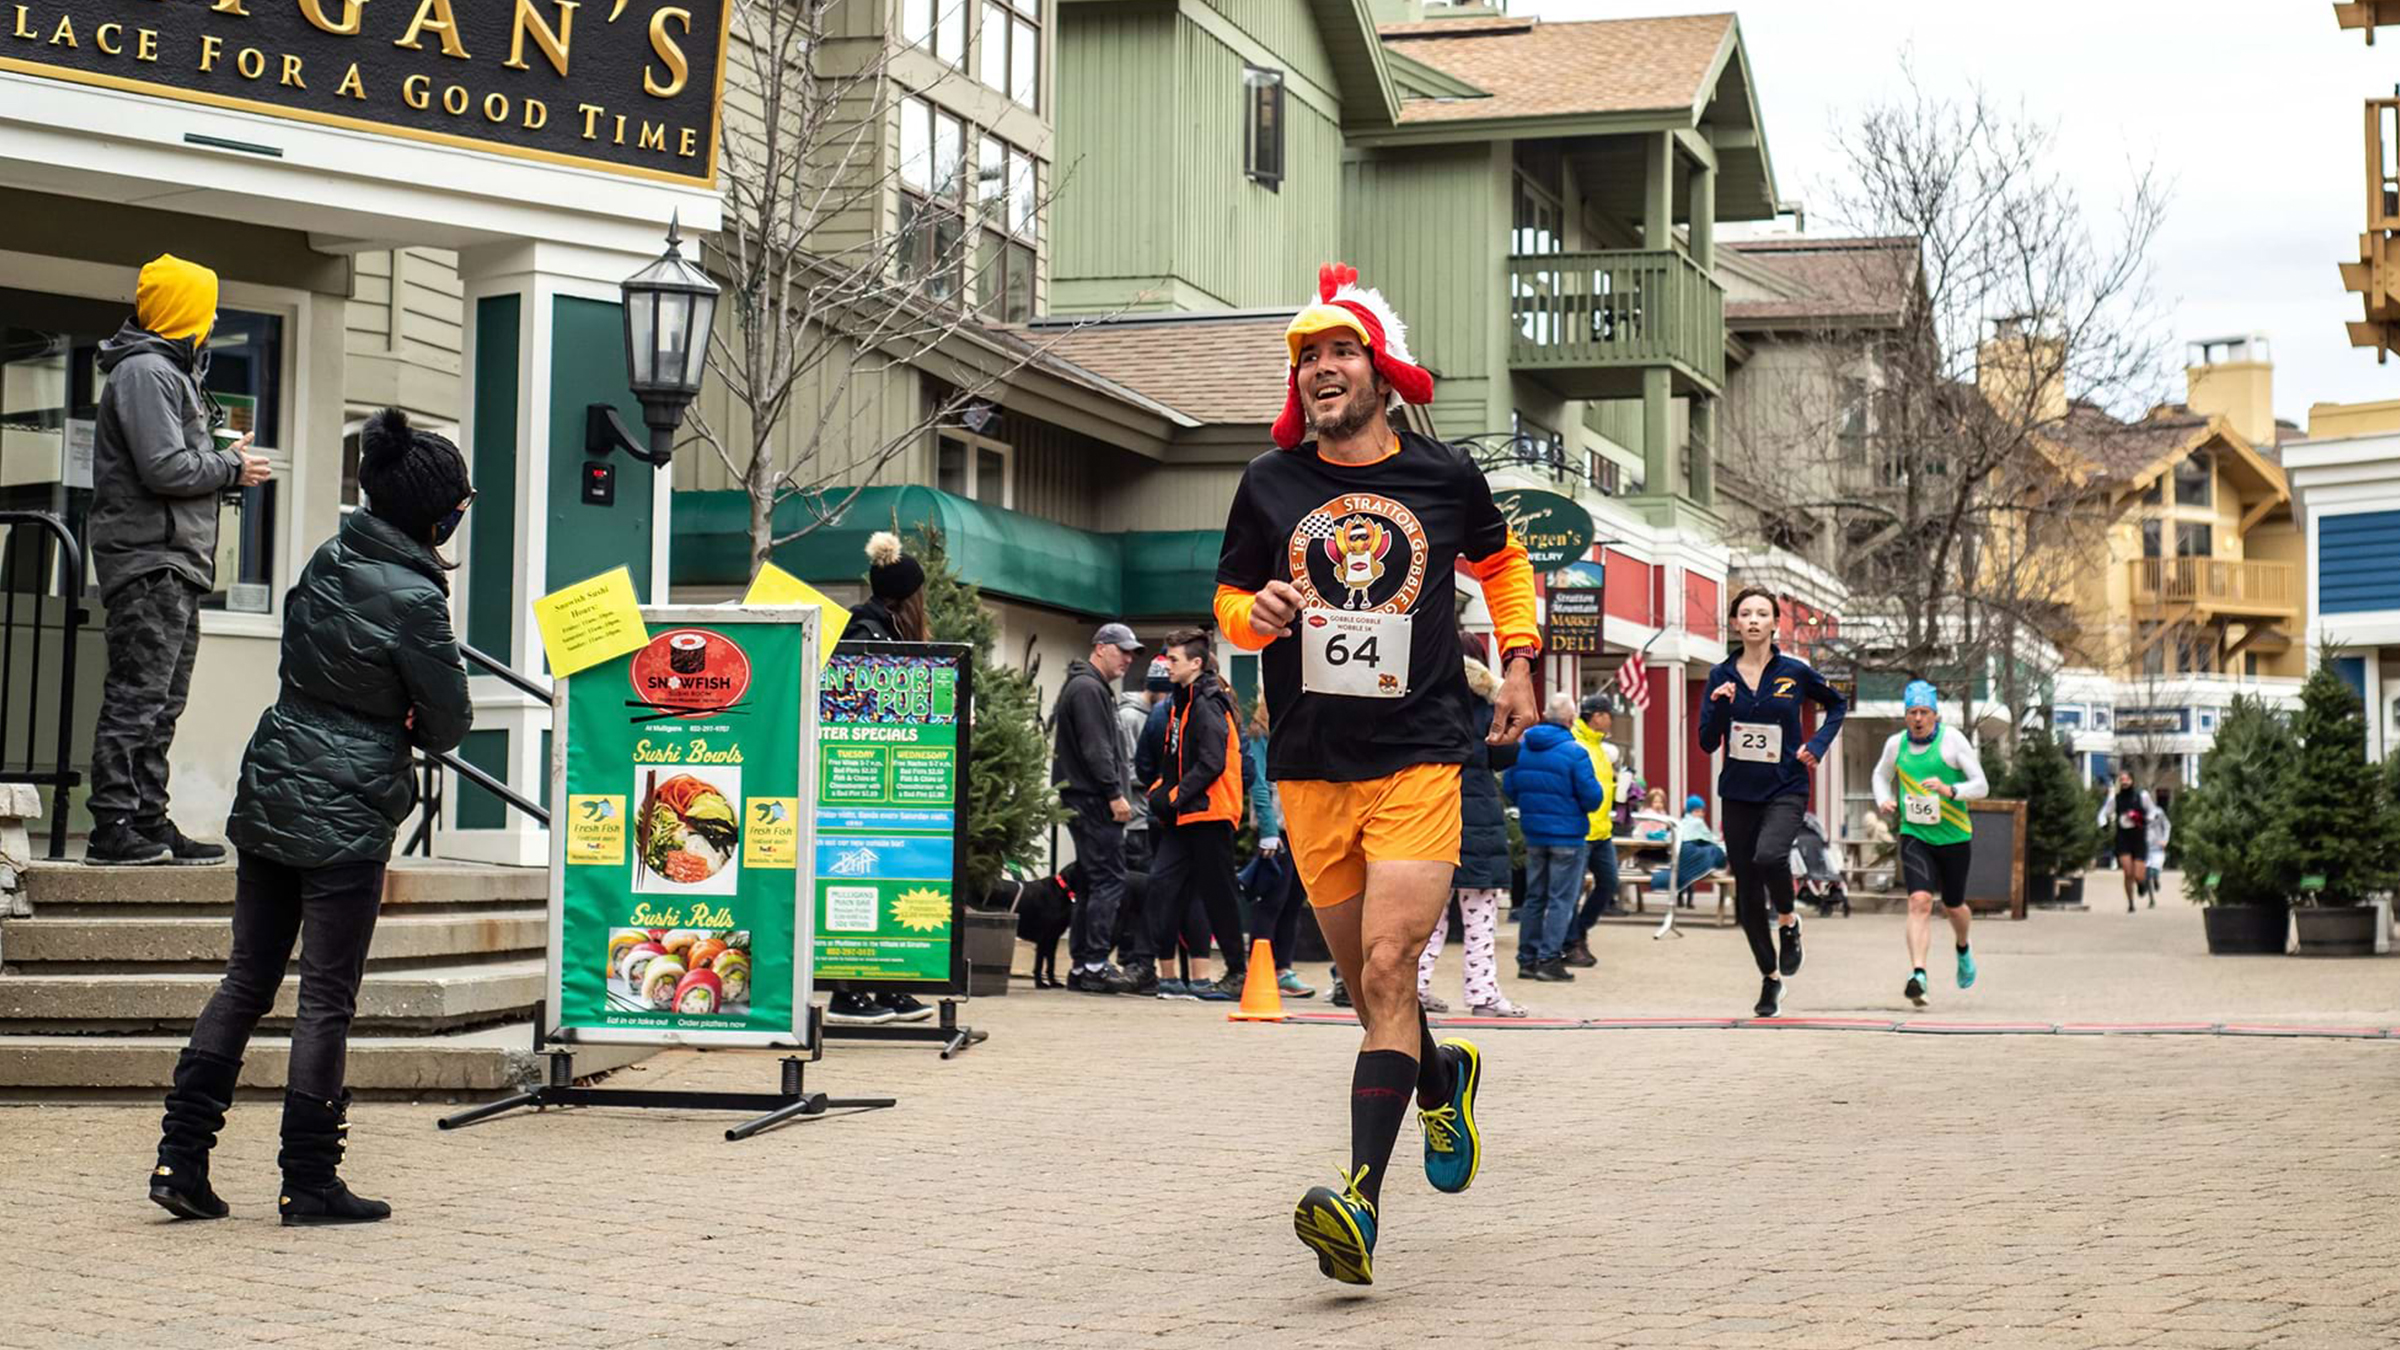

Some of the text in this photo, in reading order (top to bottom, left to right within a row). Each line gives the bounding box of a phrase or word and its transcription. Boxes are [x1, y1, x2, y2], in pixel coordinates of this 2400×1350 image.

[14, 5, 697, 156] LACE FOR A GOOD TIME
[1344, 498, 1418, 535] STRATTON
[1397, 538, 1425, 605] GOBBLE
[1555, 593, 1595, 605] Stratton
[1552, 604, 1598, 613] Mountain
[1330, 615, 1354, 623] GOBBLE
[1356, 616, 1381, 624] GOBBLE
[1551, 615, 1599, 626] MARKET
[1551, 636, 1595, 650] DELI
[1325, 634, 1380, 668] 64
[648, 676, 730, 690] SNOWFISH
[854, 665, 929, 692] DOOR
[877, 691, 929, 716] PUB
[852, 727, 918, 742] SPECIALS
[1742, 733, 1767, 749] 23
[633, 738, 744, 762] Sushi Bowls
[574, 823, 620, 832] Fresh Fish
[750, 826, 792, 835] Fresh Fish
[630, 902, 735, 928] Sushi Rolls
[607, 1016, 620, 1024] Eat
[637, 1017, 655, 1025] take
[656, 1018, 668, 1026] out
[677, 1018, 747, 1028] Order platters now
